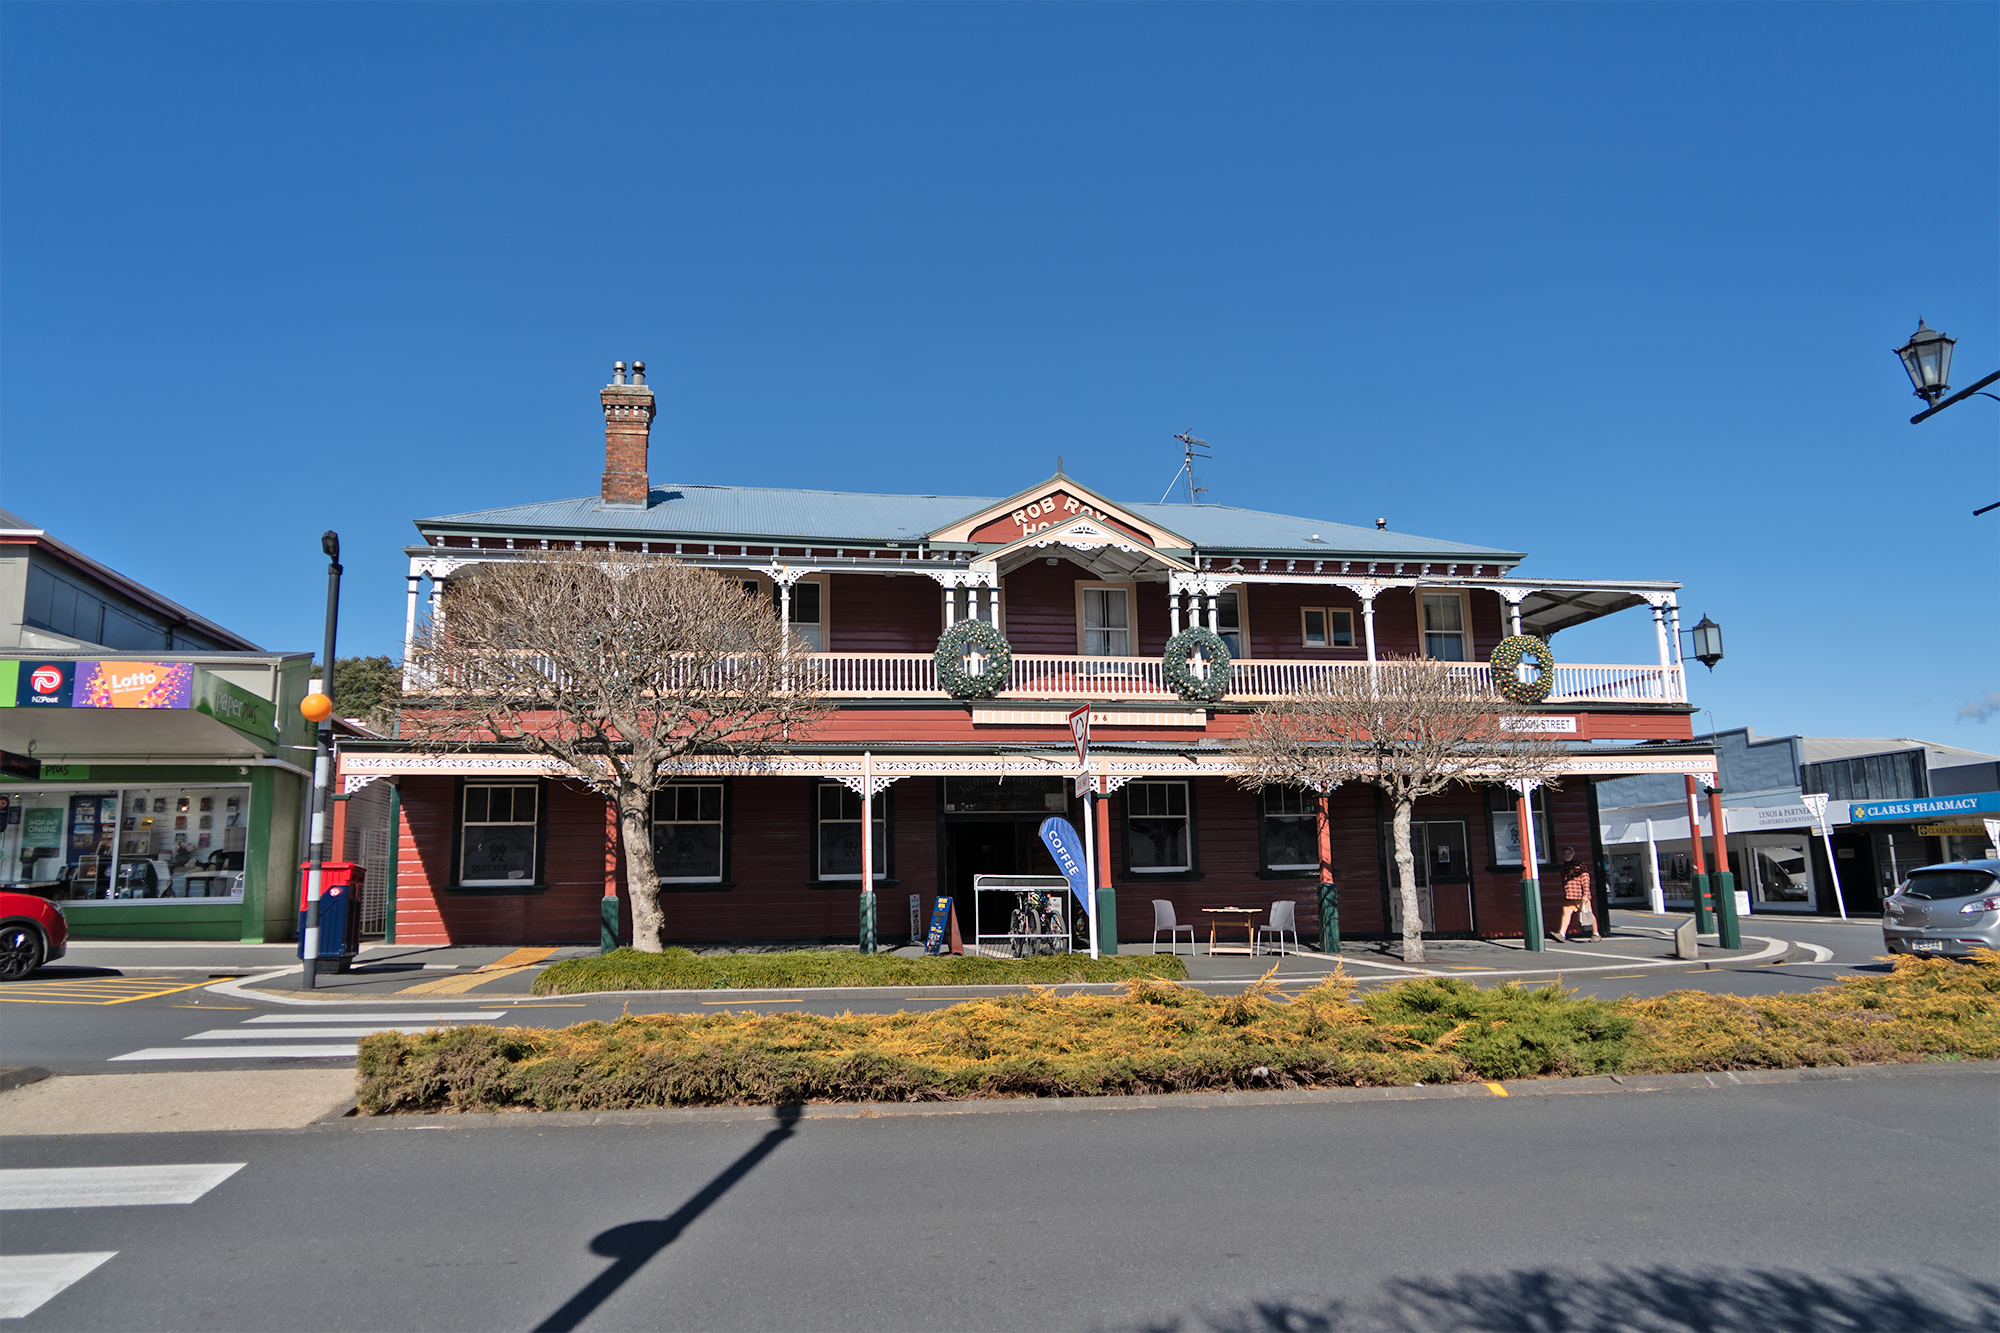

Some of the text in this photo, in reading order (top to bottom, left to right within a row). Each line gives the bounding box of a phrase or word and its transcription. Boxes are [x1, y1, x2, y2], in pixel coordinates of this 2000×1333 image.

[1011, 496, 1108, 527] ROB ROY
[1022, 520, 1061, 537] HO
[111, 672, 156, 689] Lotto
[1065, 714, 1107, 722] 196
[1541, 719, 1571, 730] STREET
[1758, 810, 1777, 818] LYNCH
[1784, 807, 1811, 816] PARTNER
[1867, 798, 1978, 817] CLARKS PHARMACY
[1784, 815, 1816, 824] ACCOUNTANTS
[1049, 830, 1080, 876] COFFEE
